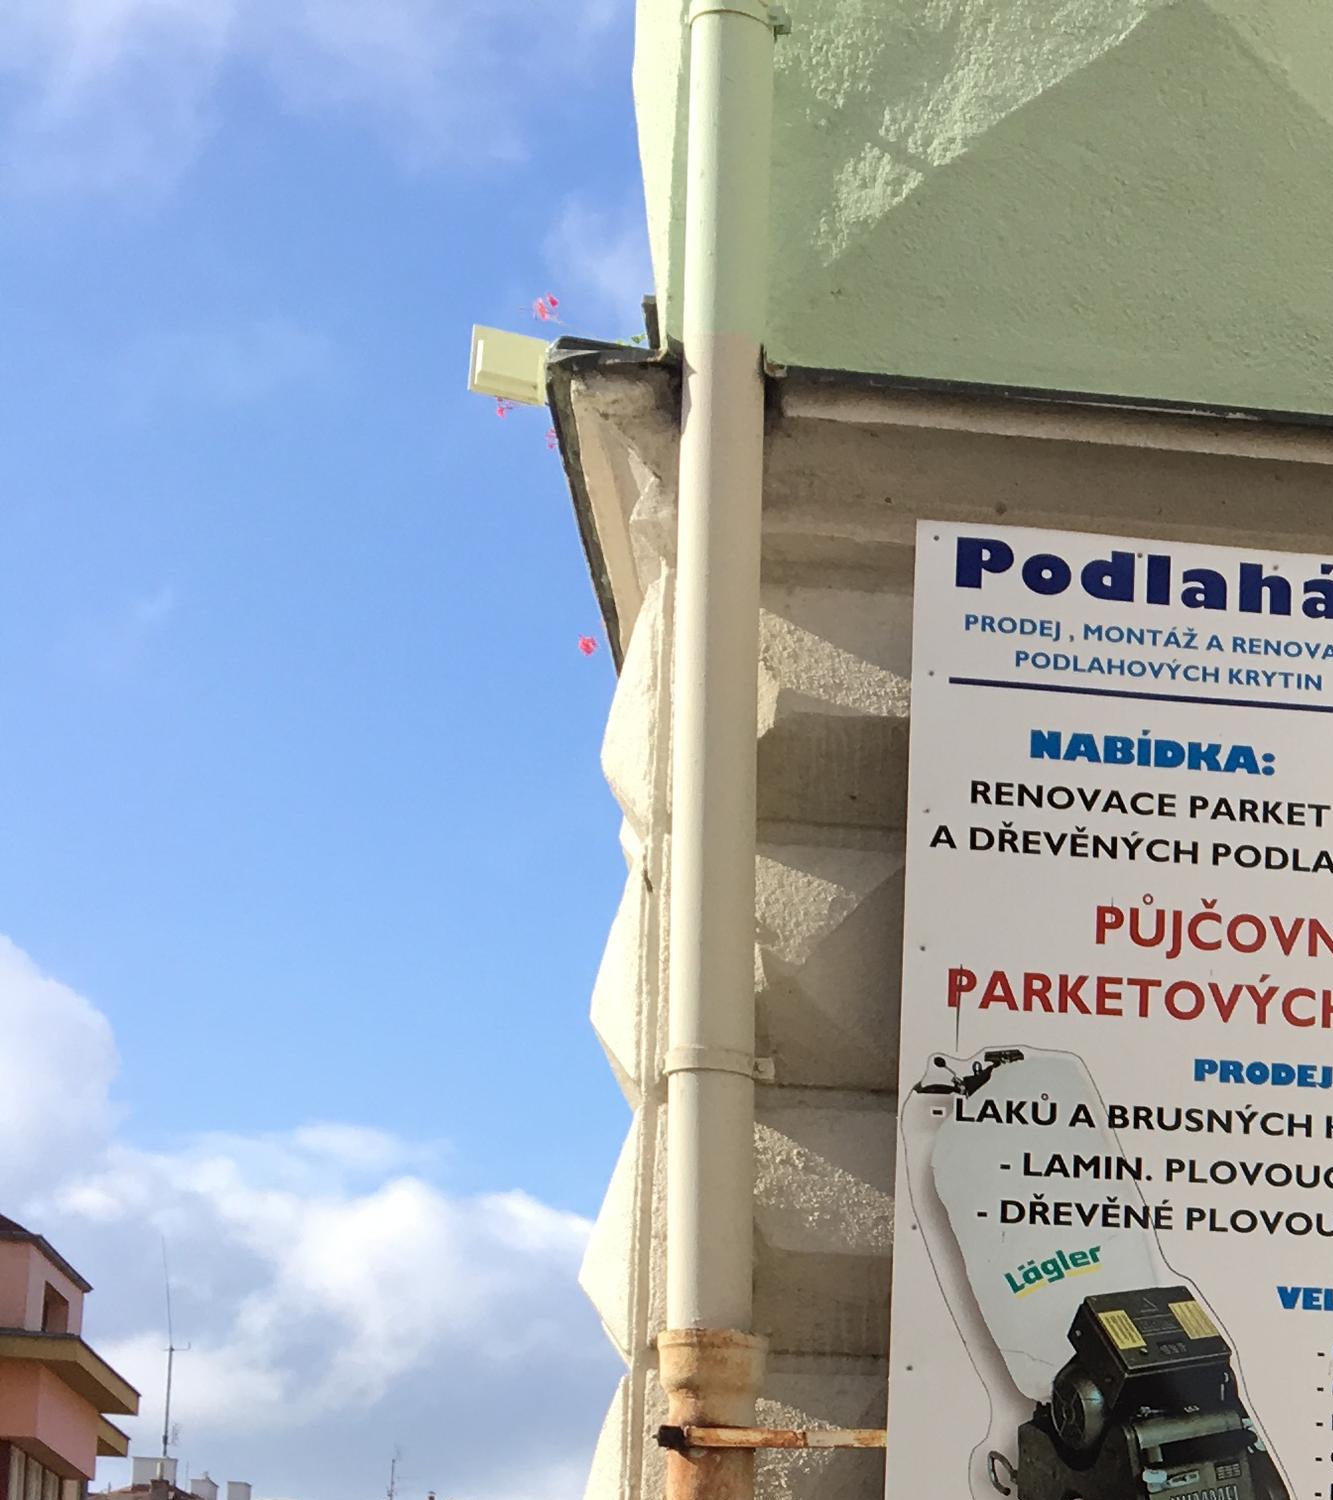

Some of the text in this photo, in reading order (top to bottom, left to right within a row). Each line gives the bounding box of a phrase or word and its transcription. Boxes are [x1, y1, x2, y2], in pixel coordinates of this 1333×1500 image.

[963, 613, 1062, 643] PRODEJ
[1082, 619, 1199, 652] MONTÁŽ
[1205, 634, 1225, 653] A
[1014, 649, 1323, 692] PODLAHOVÝCH KRYTIN
[1029, 727, 1277, 777] NABÍDKA:
[968, 779, 1331, 829] RENOVACE PARKET
[928, 824, 958, 851] A
[968, 817, 1199, 866] DŘEVĚNÝCH
[1193, 1057, 1333, 1090] PRODEJ
[953, 1092, 1058, 1127] LAKŮ
[1068, 1103, 1096, 1129] A
[1107, 1102, 1313, 1139] BRUSNÝCH
[1022, 1151, 1154, 1184] LAMIN.
[999, 1193, 1173, 1232] DŘEVĚNÉ
[1004, 1245, 1102, 1294] Lägler
